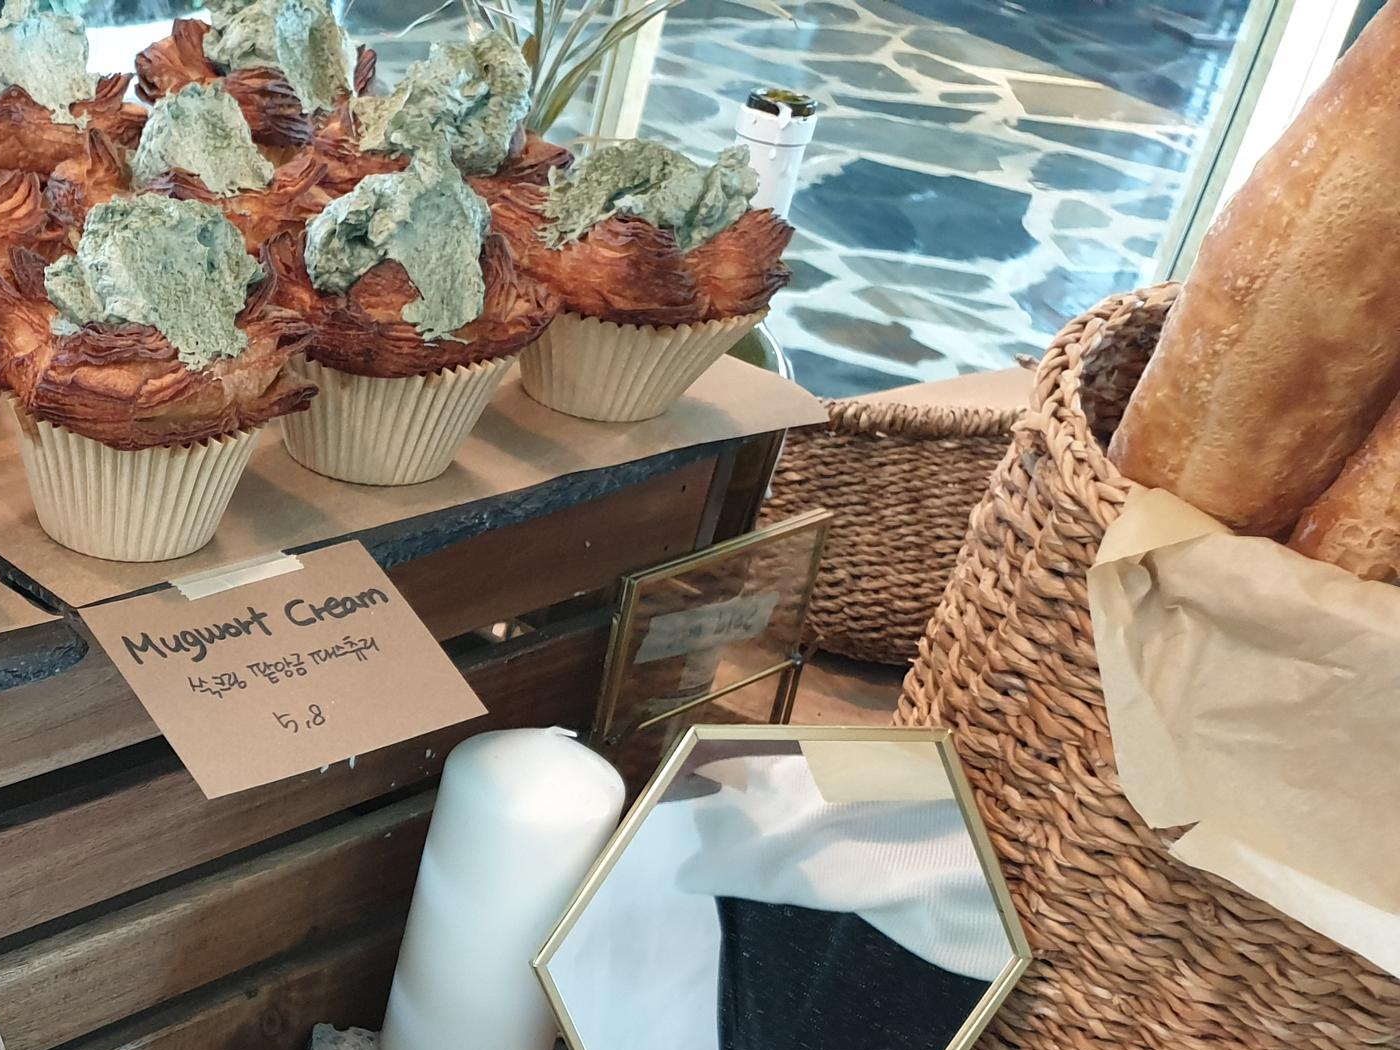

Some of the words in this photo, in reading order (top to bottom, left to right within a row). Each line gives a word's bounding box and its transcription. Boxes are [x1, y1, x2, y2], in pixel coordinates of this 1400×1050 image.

[121, 607, 272, 664] Mugwort
[284, 587, 389, 628] Cream
[245, 653, 308, 684] 팥앙금
